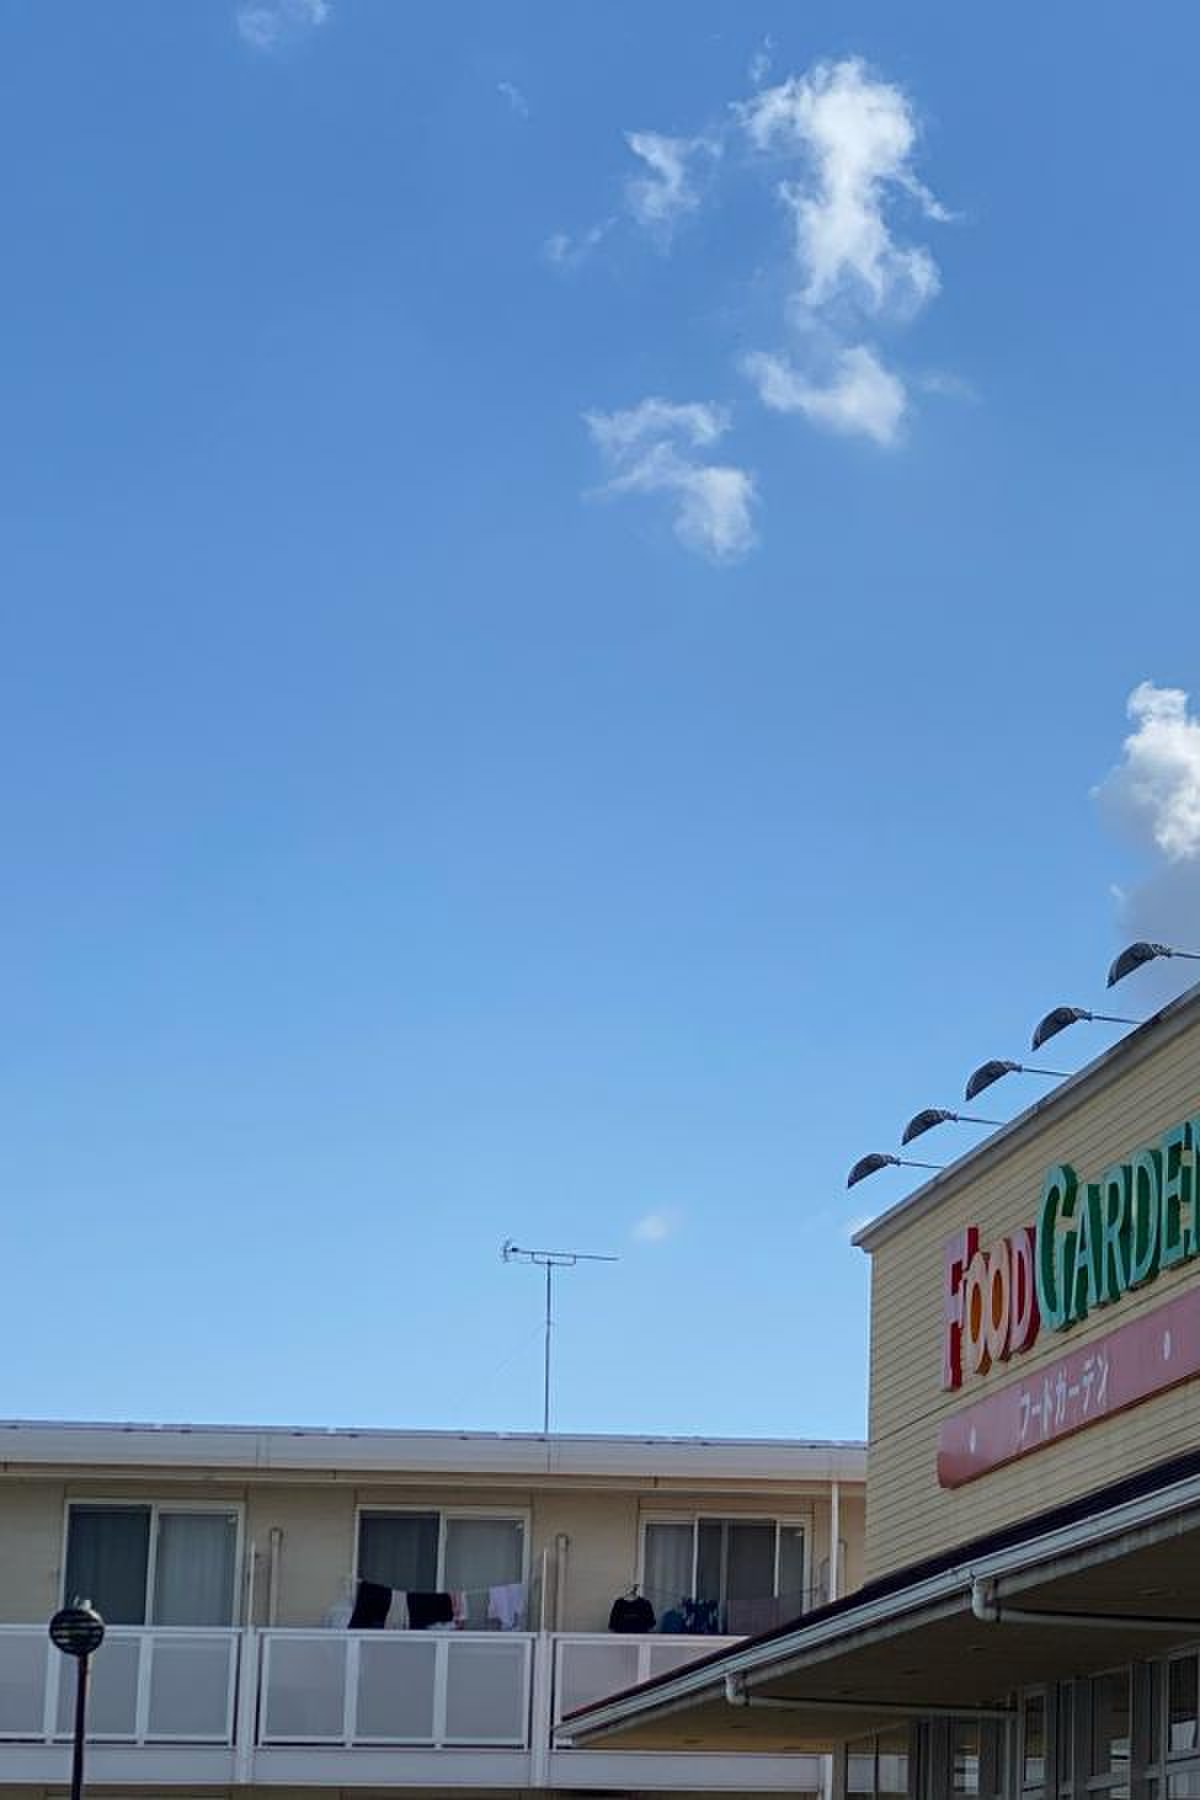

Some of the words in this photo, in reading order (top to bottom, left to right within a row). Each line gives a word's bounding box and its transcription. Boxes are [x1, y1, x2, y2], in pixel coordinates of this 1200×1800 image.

[943, 1226, 1040, 1391] FOOD
[1020, 1354, 1110, 1440] フードガーデン
